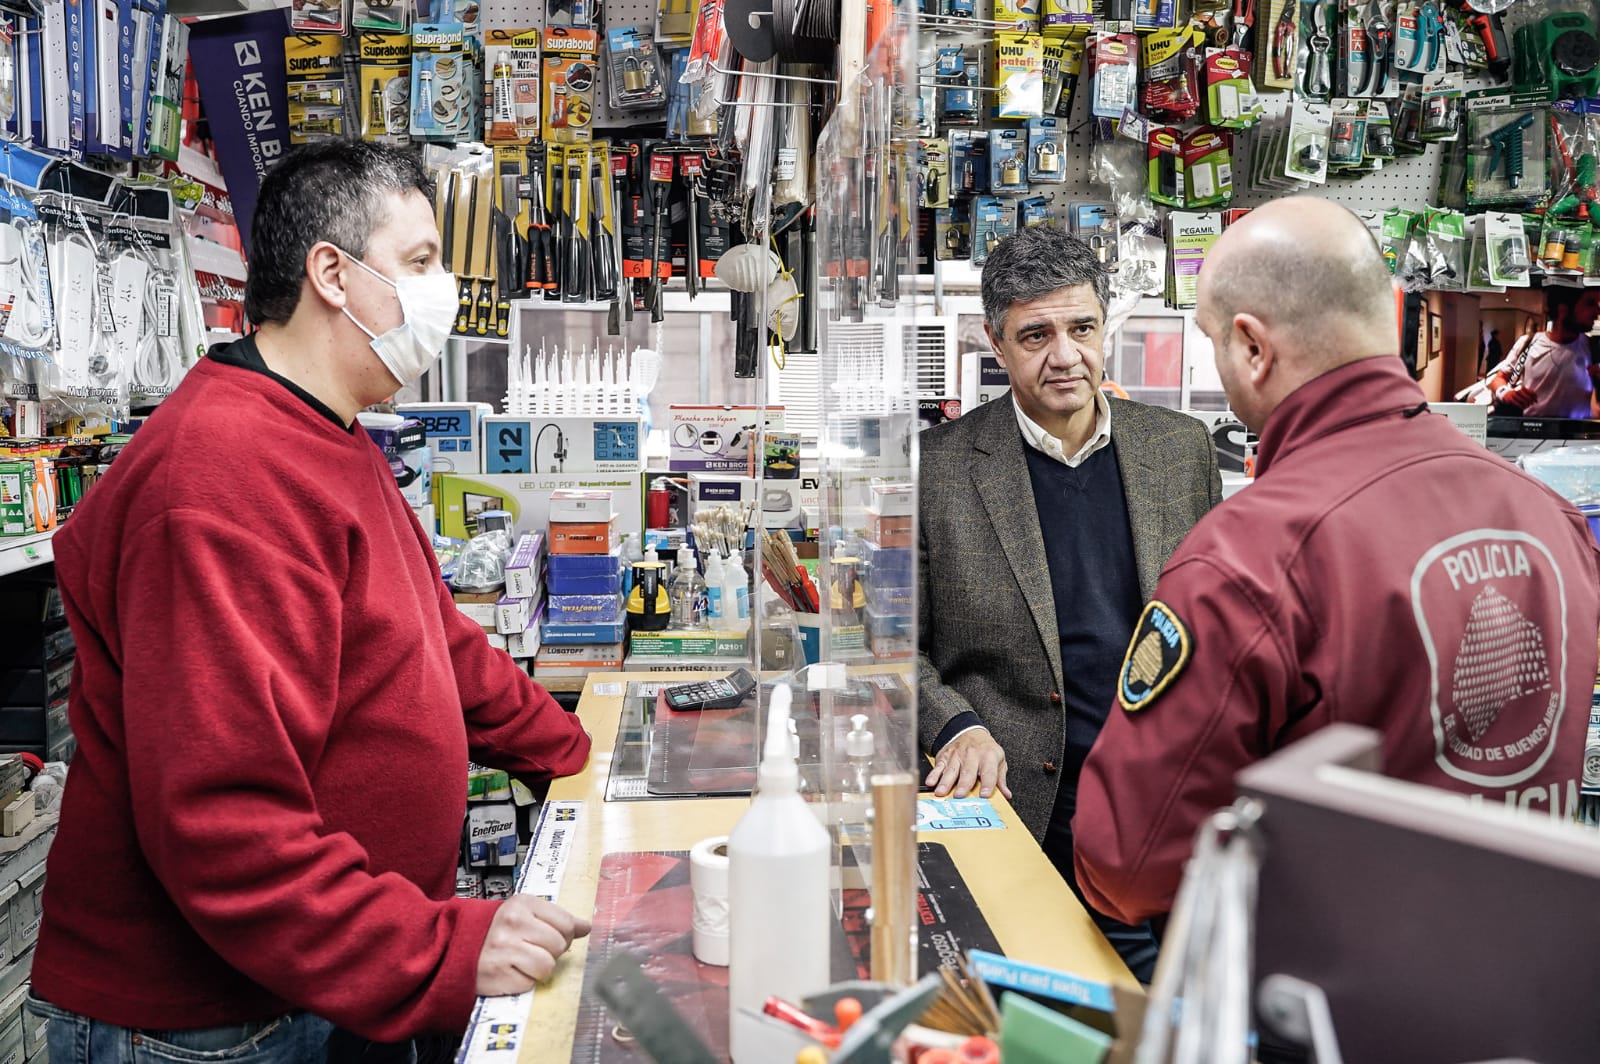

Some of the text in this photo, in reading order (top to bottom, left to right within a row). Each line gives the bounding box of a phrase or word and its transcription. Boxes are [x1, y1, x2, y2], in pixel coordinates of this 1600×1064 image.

[514, 38, 534, 46] UHU
[1150, 40, 1170, 51] UHU
[1001, 46, 1024, 56] UHU
[233, 80, 254, 131] CUANDO
[242, 72, 277, 132] KEN
[774, 440, 799, 448] crazy
[539, 481, 556, 489] LCD
[559, 481, 575, 489] PDP
[1442, 544, 1531, 590] POLICIA
[1485, 747, 1504, 761] DE
[1504, 723, 1548, 759] BUENOS
[1543, 691, 1560, 728] AIRES
[472, 821, 513, 837] Energizer
